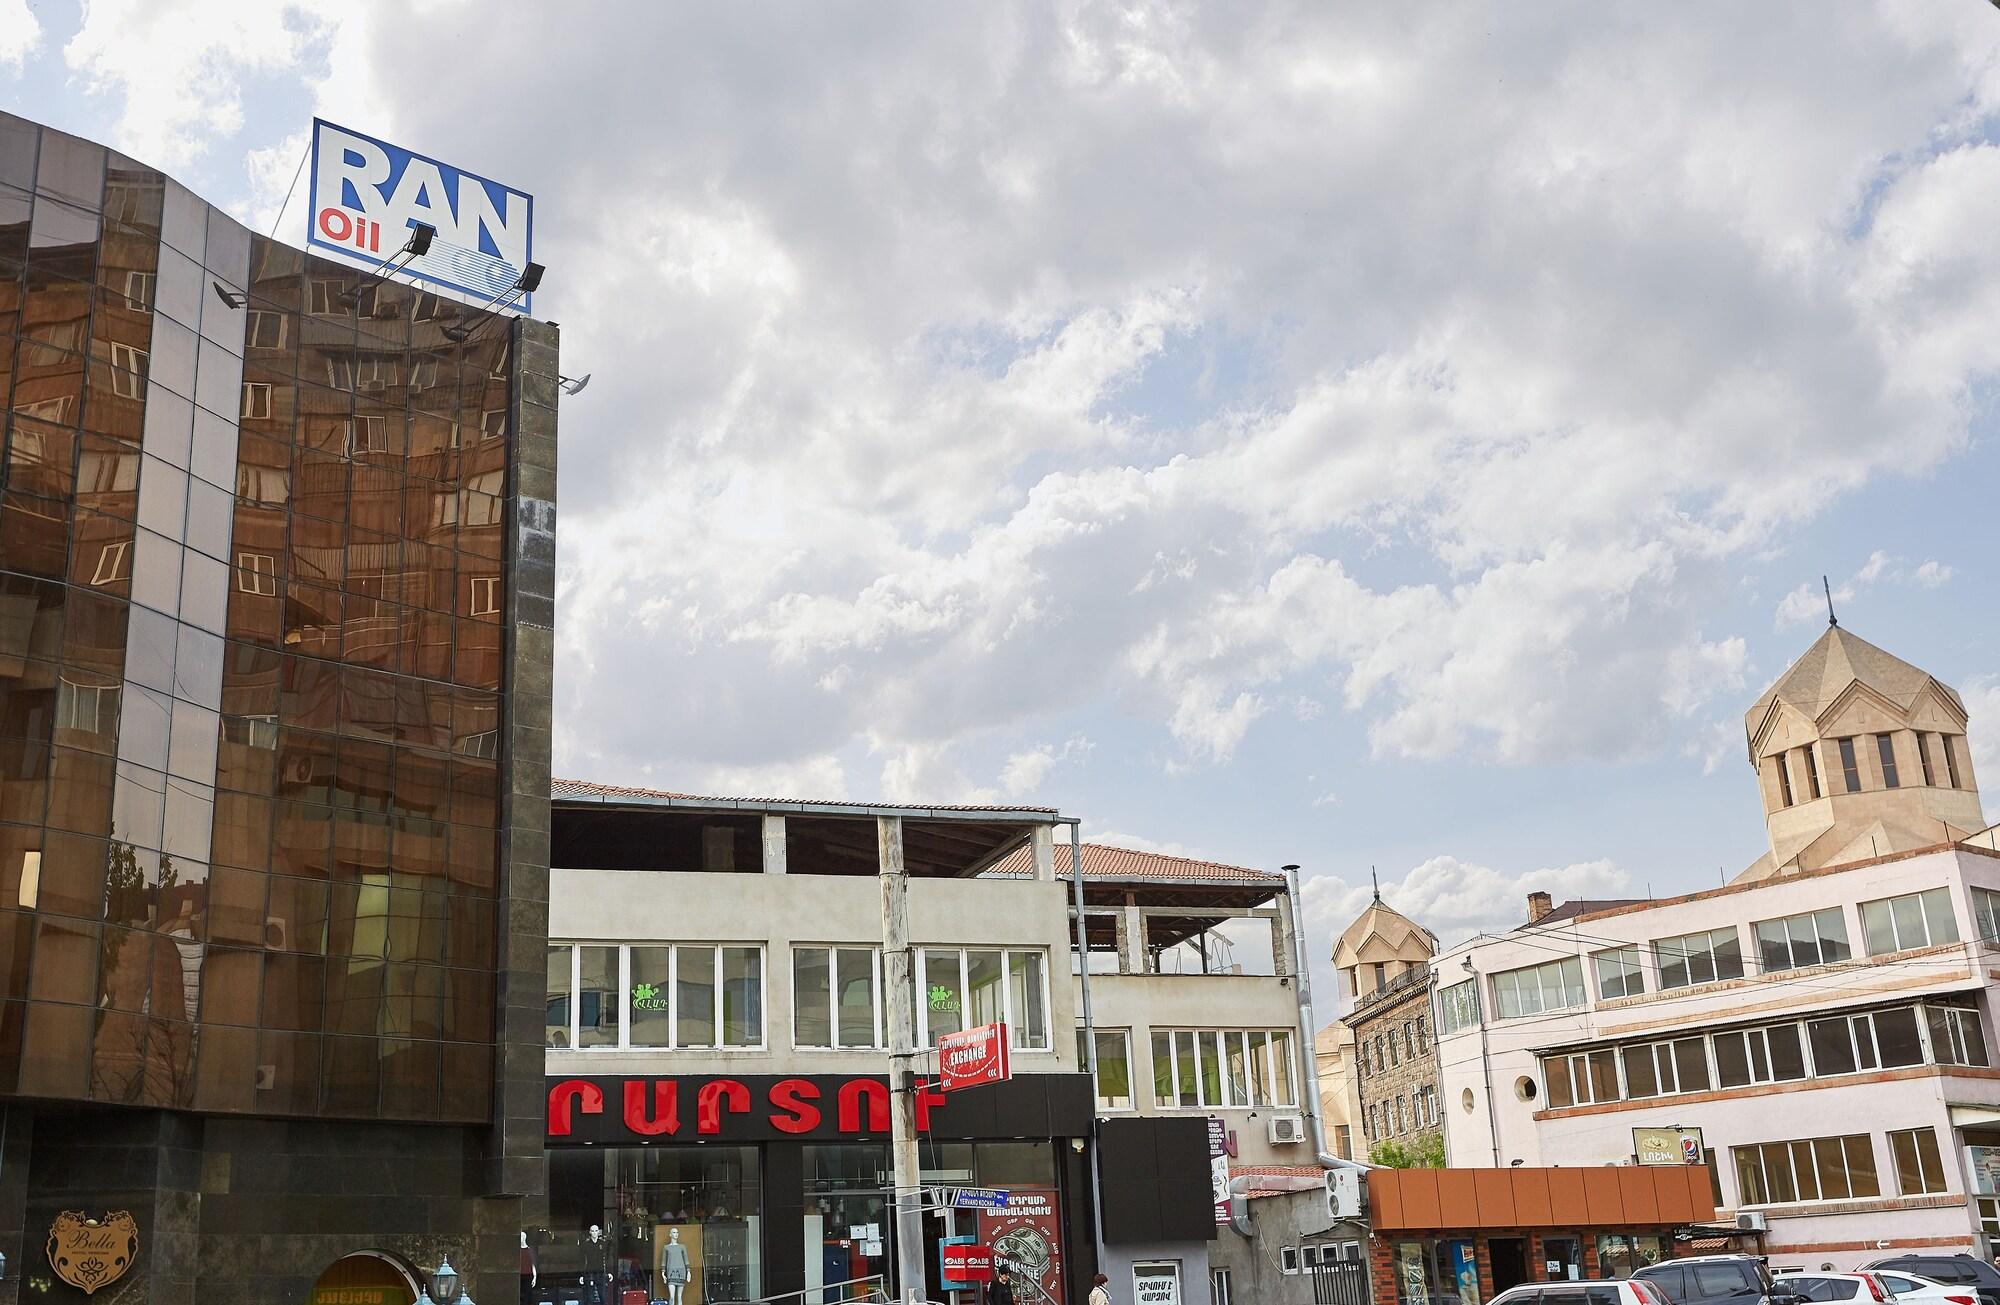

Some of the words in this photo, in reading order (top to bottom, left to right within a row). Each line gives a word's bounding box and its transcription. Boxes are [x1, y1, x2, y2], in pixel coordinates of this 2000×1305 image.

[318, 124, 528, 264] RAN
[319, 207, 380, 253] Oil
[950, 1045, 987, 1066] EXCHANGE
[66, 1230, 117, 1249] Bella
